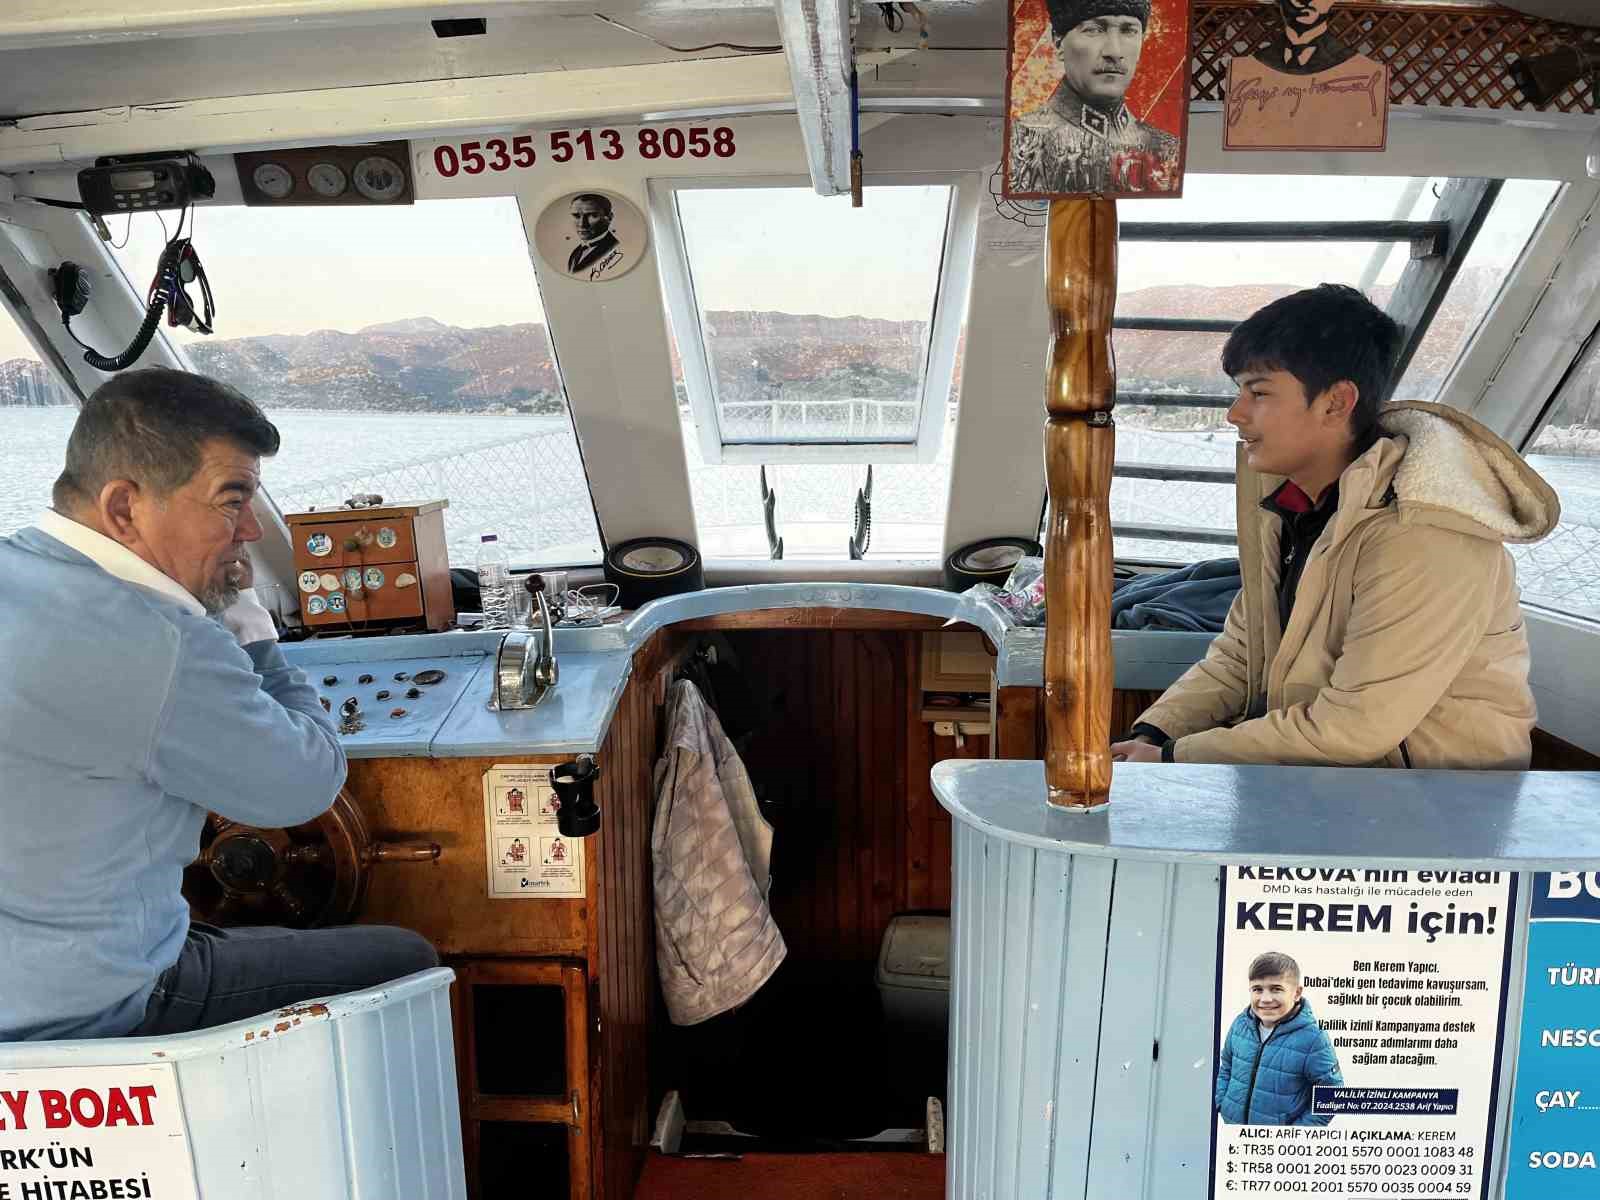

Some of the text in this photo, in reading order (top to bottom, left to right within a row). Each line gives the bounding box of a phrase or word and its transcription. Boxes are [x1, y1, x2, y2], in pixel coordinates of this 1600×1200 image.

[433, 126, 736, 177] 0535 513 8058
[1263, 884, 1473, 897] DMD kas hastalığı ile mücadele eden
[1236, 901, 1497, 943] KEREM için!
[1353, 960, 1440, 975] Ben Kerem Yapıcı.
[1303, 976, 1489, 993] Dubai'deki gen tedavime kavuşursam,
[1328, 993, 1463, 1009] sağlıklı bir çocuk olabilirim.
[1318, 1019, 1476, 1034] Valilik izinli Kampanyama destek
[1333, 1036, 1458, 1049] olursanız adımlarımı daha
[1352, 1052, 1438, 1067] sağlam atacağım.
[1392, 1091, 1439, 1100] KAMPANYA
[0, 1085, 157, 1130] Y BOAT
[1316, 1101, 1345, 1111] Faaliyet
[1361, 1102, 1415, 1110] 07.2024.2538
[1417, 1102, 1430, 1111] Arif
[1239, 1128, 1273, 1138] ALICI:
[1275, 1127, 1302, 1139] ARİF
[1304, 1130, 1341, 1140] YAPICI
[1350, 1130, 1414, 1142] AÇIKLAMA:
[1417, 1131, 1456, 1141] KEREM
[1243, 1144, 1275, 1156] TR35
[1278, 1144, 1312, 1156] 0001
[1315, 1145, 1349, 1157] 2001
[1351, 1146, 1383, 1157] 5570
[1386, 1146, 1420, 1158] 0001
[1423, 1146, 1455, 1158] 1083
[1458, 1146, 1474, 1158] 48
[1528, 1151, 1597, 1169] SODA
[1226, 1160, 1473, 1176] $: TR58 0001 2001 5570 0023 0009 31
[21, 1171, 152, 1200] HİTABESİ
[1225, 1179, 1471, 1194] €: TR77 0001 2001 5570 0035 0004 59
